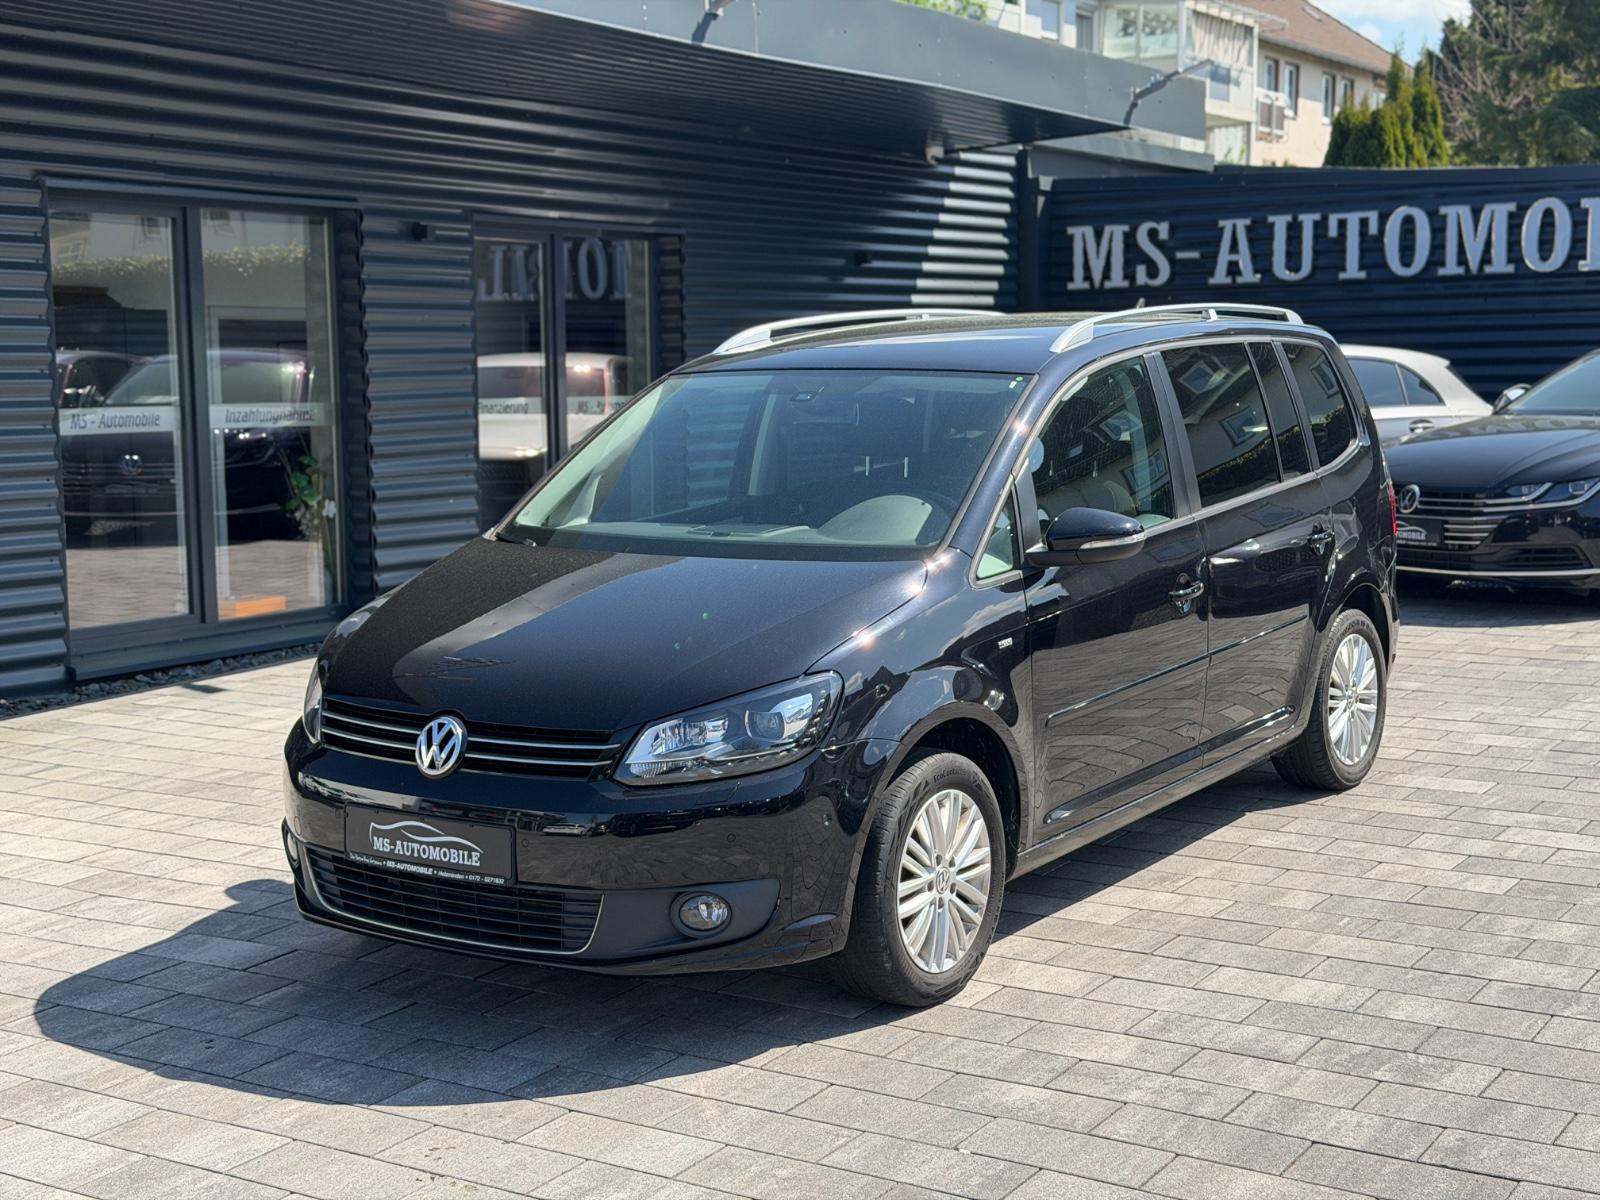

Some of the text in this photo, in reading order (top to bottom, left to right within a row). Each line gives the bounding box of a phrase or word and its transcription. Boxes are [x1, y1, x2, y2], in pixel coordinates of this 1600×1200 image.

[70, 413, 88, 430] MS
[98, 412, 161, 429] Automobile
[373, 836, 481, 867] MS-AUTOMOBILE
